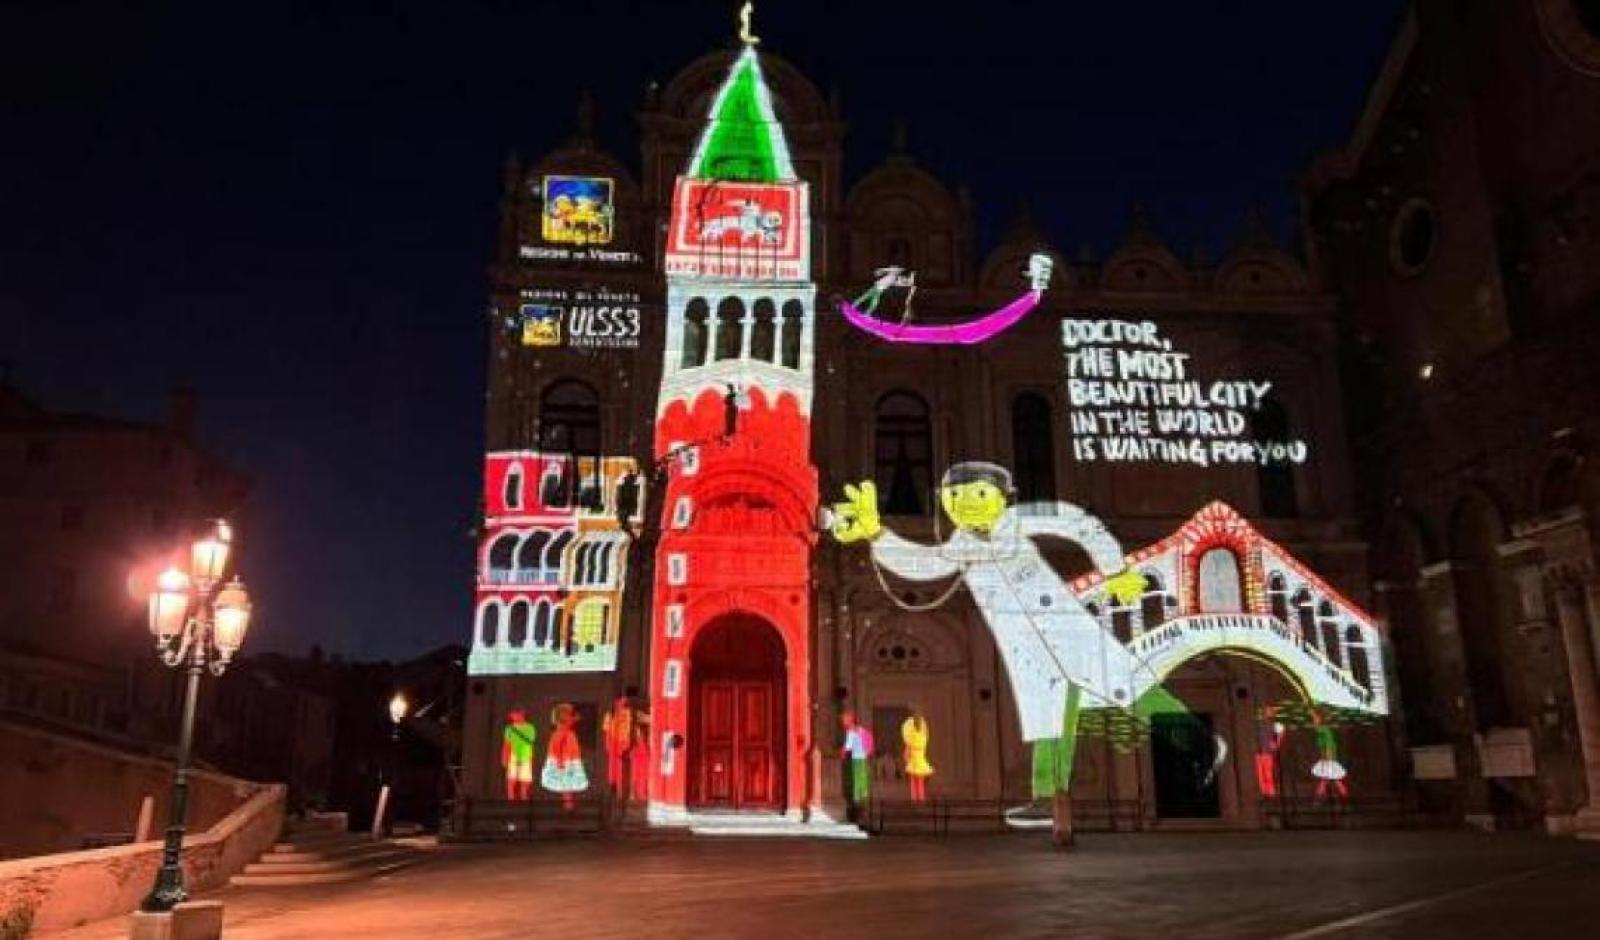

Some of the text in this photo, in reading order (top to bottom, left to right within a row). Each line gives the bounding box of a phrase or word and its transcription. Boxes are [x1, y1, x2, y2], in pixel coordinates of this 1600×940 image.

[569, 306, 640, 336] ULSS3
[1061, 318, 1172, 350] DOCTOR,
[1064, 348, 1190, 380] THE MOST
[1068, 378, 1273, 410] BEAUTIFUL CITY
[1071, 409, 1245, 436] IN THE WORLD
[1073, 437, 1307, 467] IS WAITING FOR YOU
